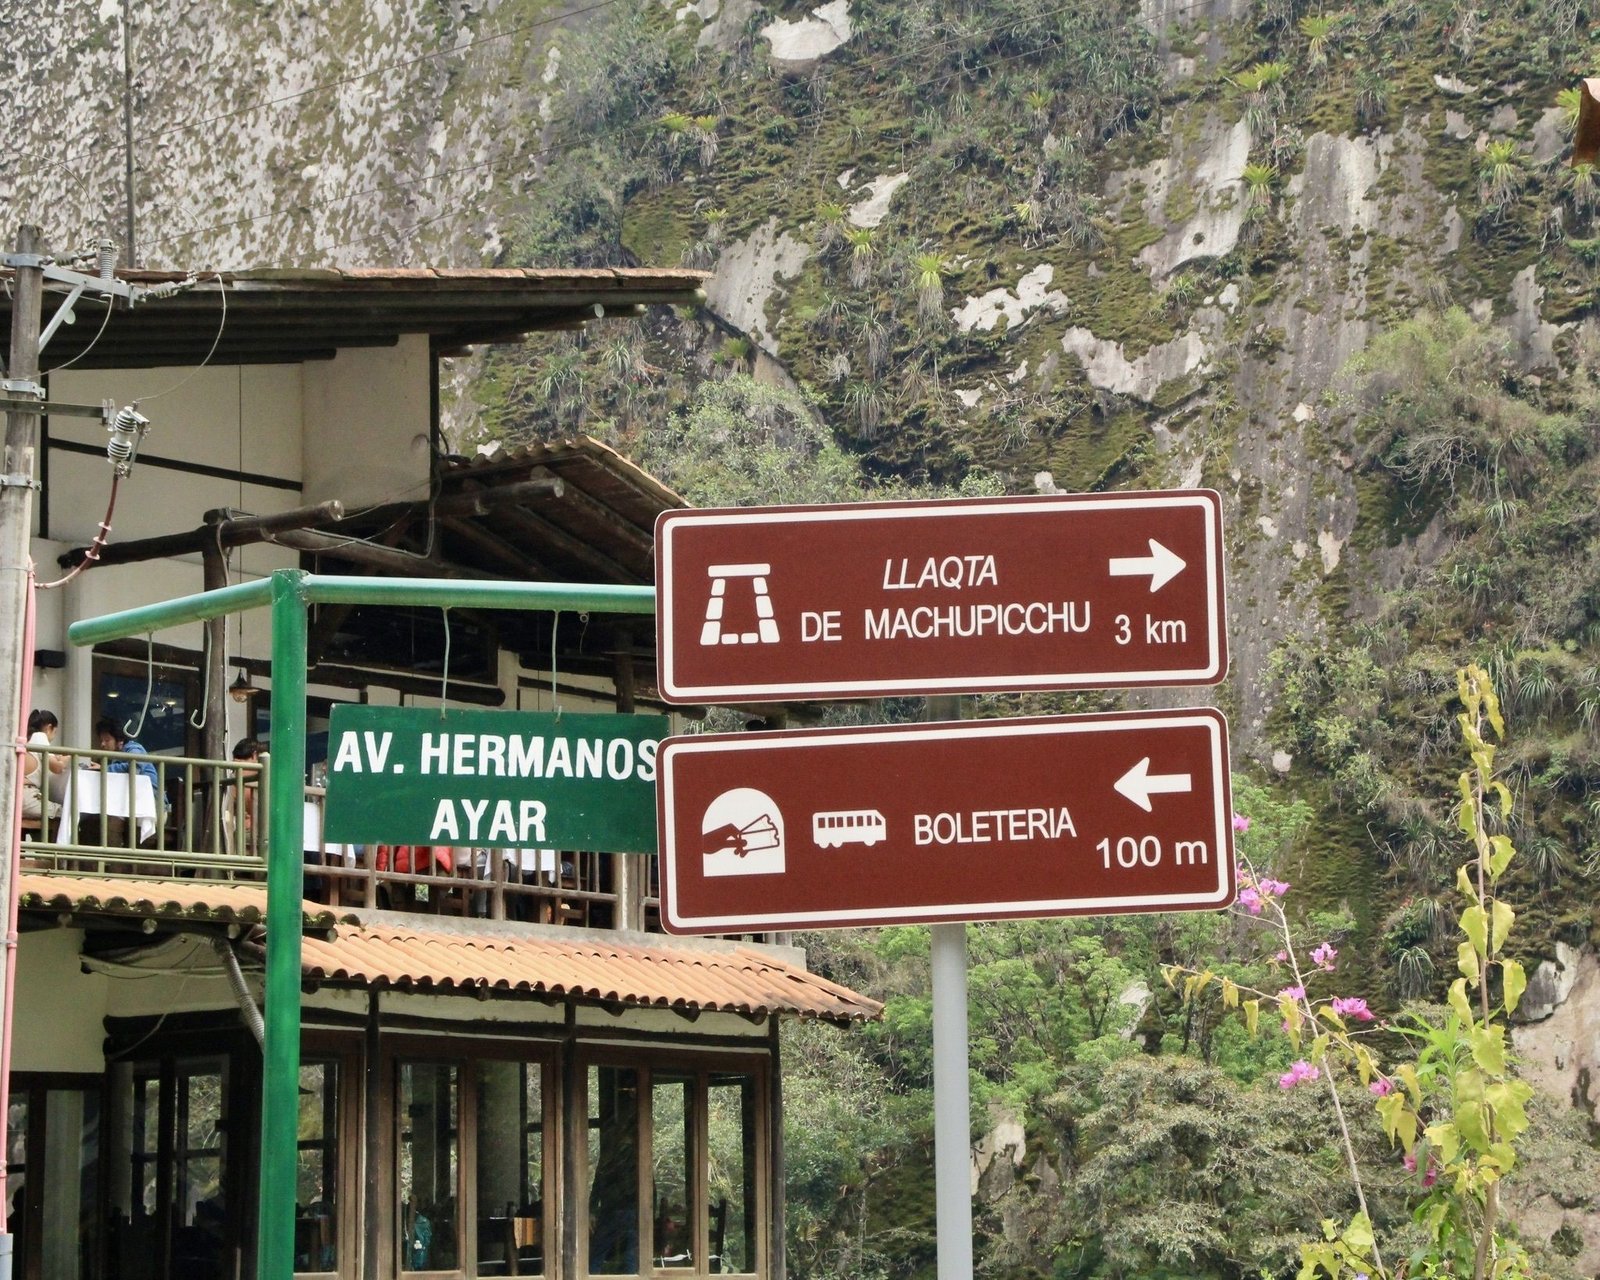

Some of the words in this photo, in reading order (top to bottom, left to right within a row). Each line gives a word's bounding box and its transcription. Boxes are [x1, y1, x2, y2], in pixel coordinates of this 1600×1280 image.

[882, 554, 998, 590] LLAQTA
[801, 610, 842, 642] DE
[864, 600, 1091, 640] MACHUPICCHU
[1114, 614, 1132, 645] 3
[1145, 613, 1187, 644] km
[333, 731, 404, 773] AV.
[420, 733, 657, 781] HERMANOS
[429, 799, 547, 842] AYAR
[914, 807, 1077, 846] BOLETERIA
[1096, 836, 1162, 869] 100
[1175, 841, 1208, 866] m
